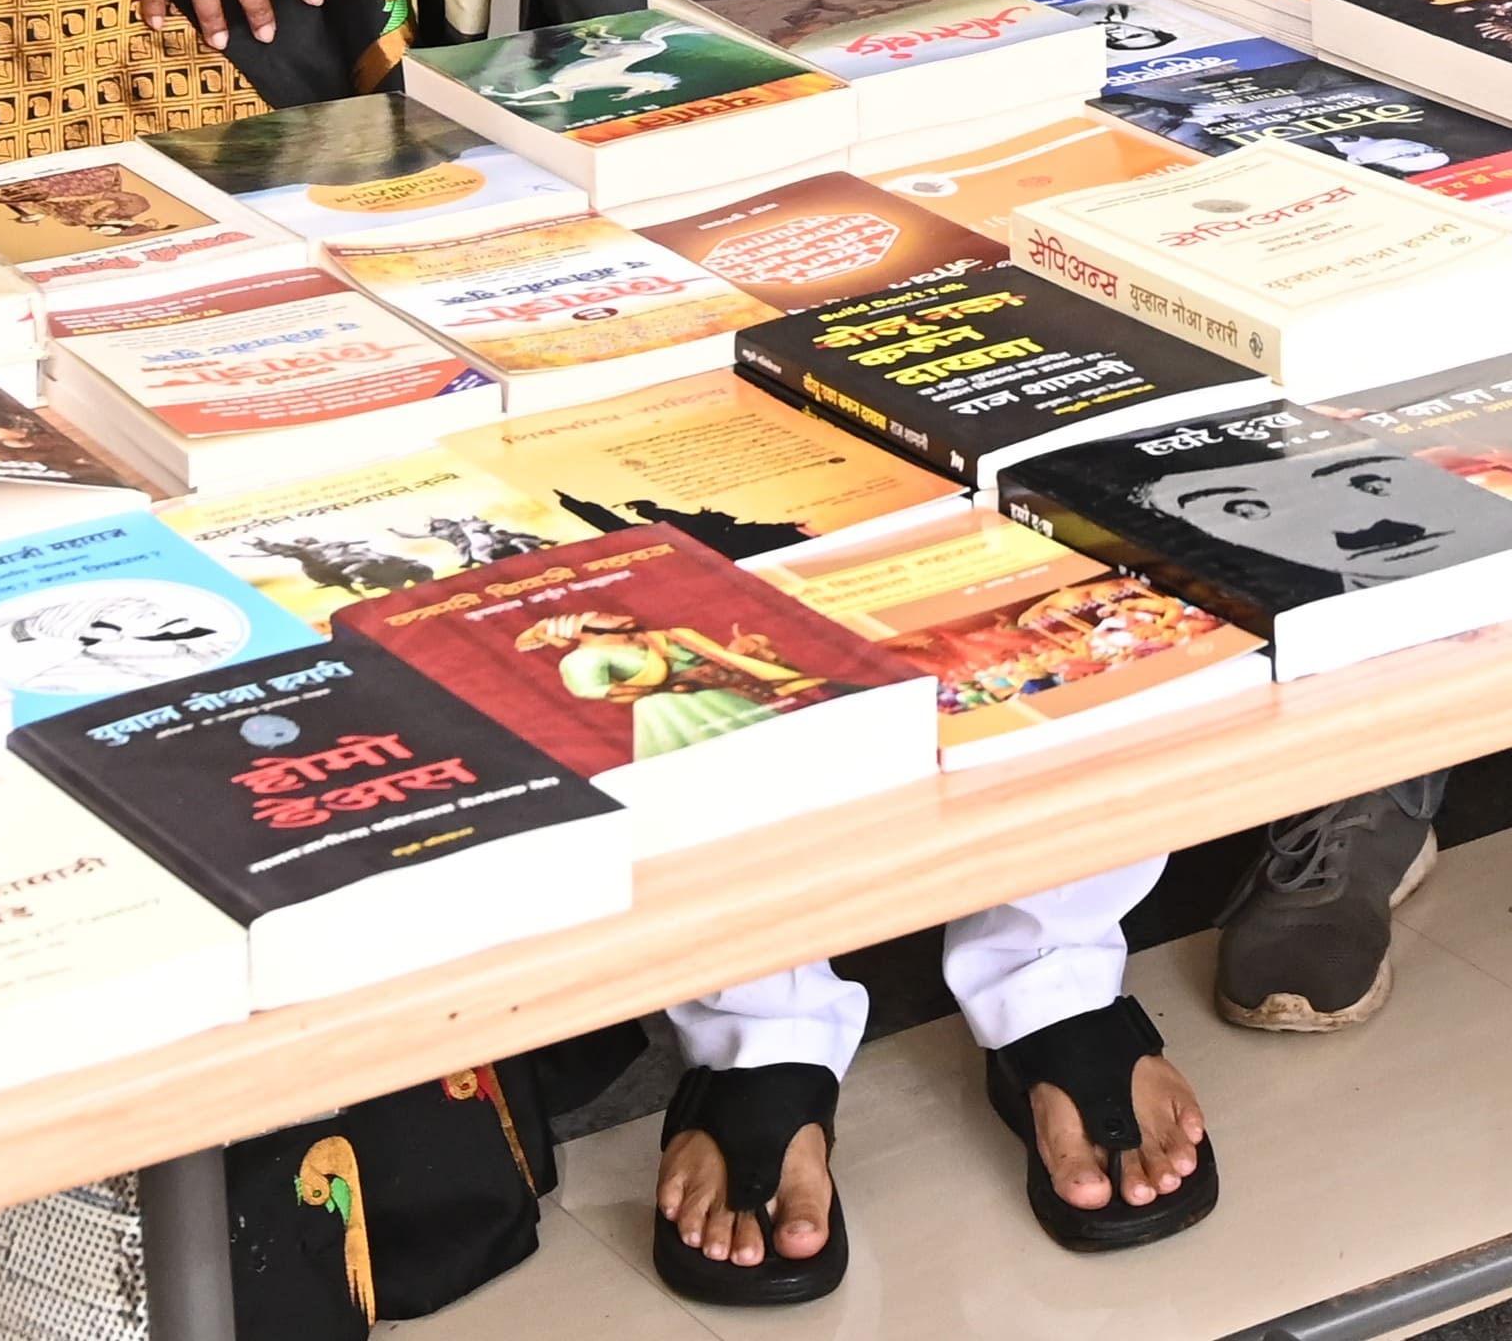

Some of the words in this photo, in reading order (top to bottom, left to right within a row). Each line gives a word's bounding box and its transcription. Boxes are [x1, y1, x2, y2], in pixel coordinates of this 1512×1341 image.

[1155, 184, 1358, 250] सेपिअन्स
[818, 303, 873, 324] Build
[872, 292, 926, 313] Don't
[925, 281, 970, 300] Talk
[1027, 228, 1120, 300] सेपिअन्स
[1129, 282, 1169, 319] युव्हाल
[1171, 297, 1204, 331] नोआ
[1205, 313, 1239, 350] हरारी
[884, 336, 1047, 386] दाखवा
[948, 389, 1020, 416] राज
[47, 527, 128, 552] महाराज
[86, 702, 183, 747] युवाल
[183, 682, 267, 713] नोआ
[230, 731, 415, 795] होमो
